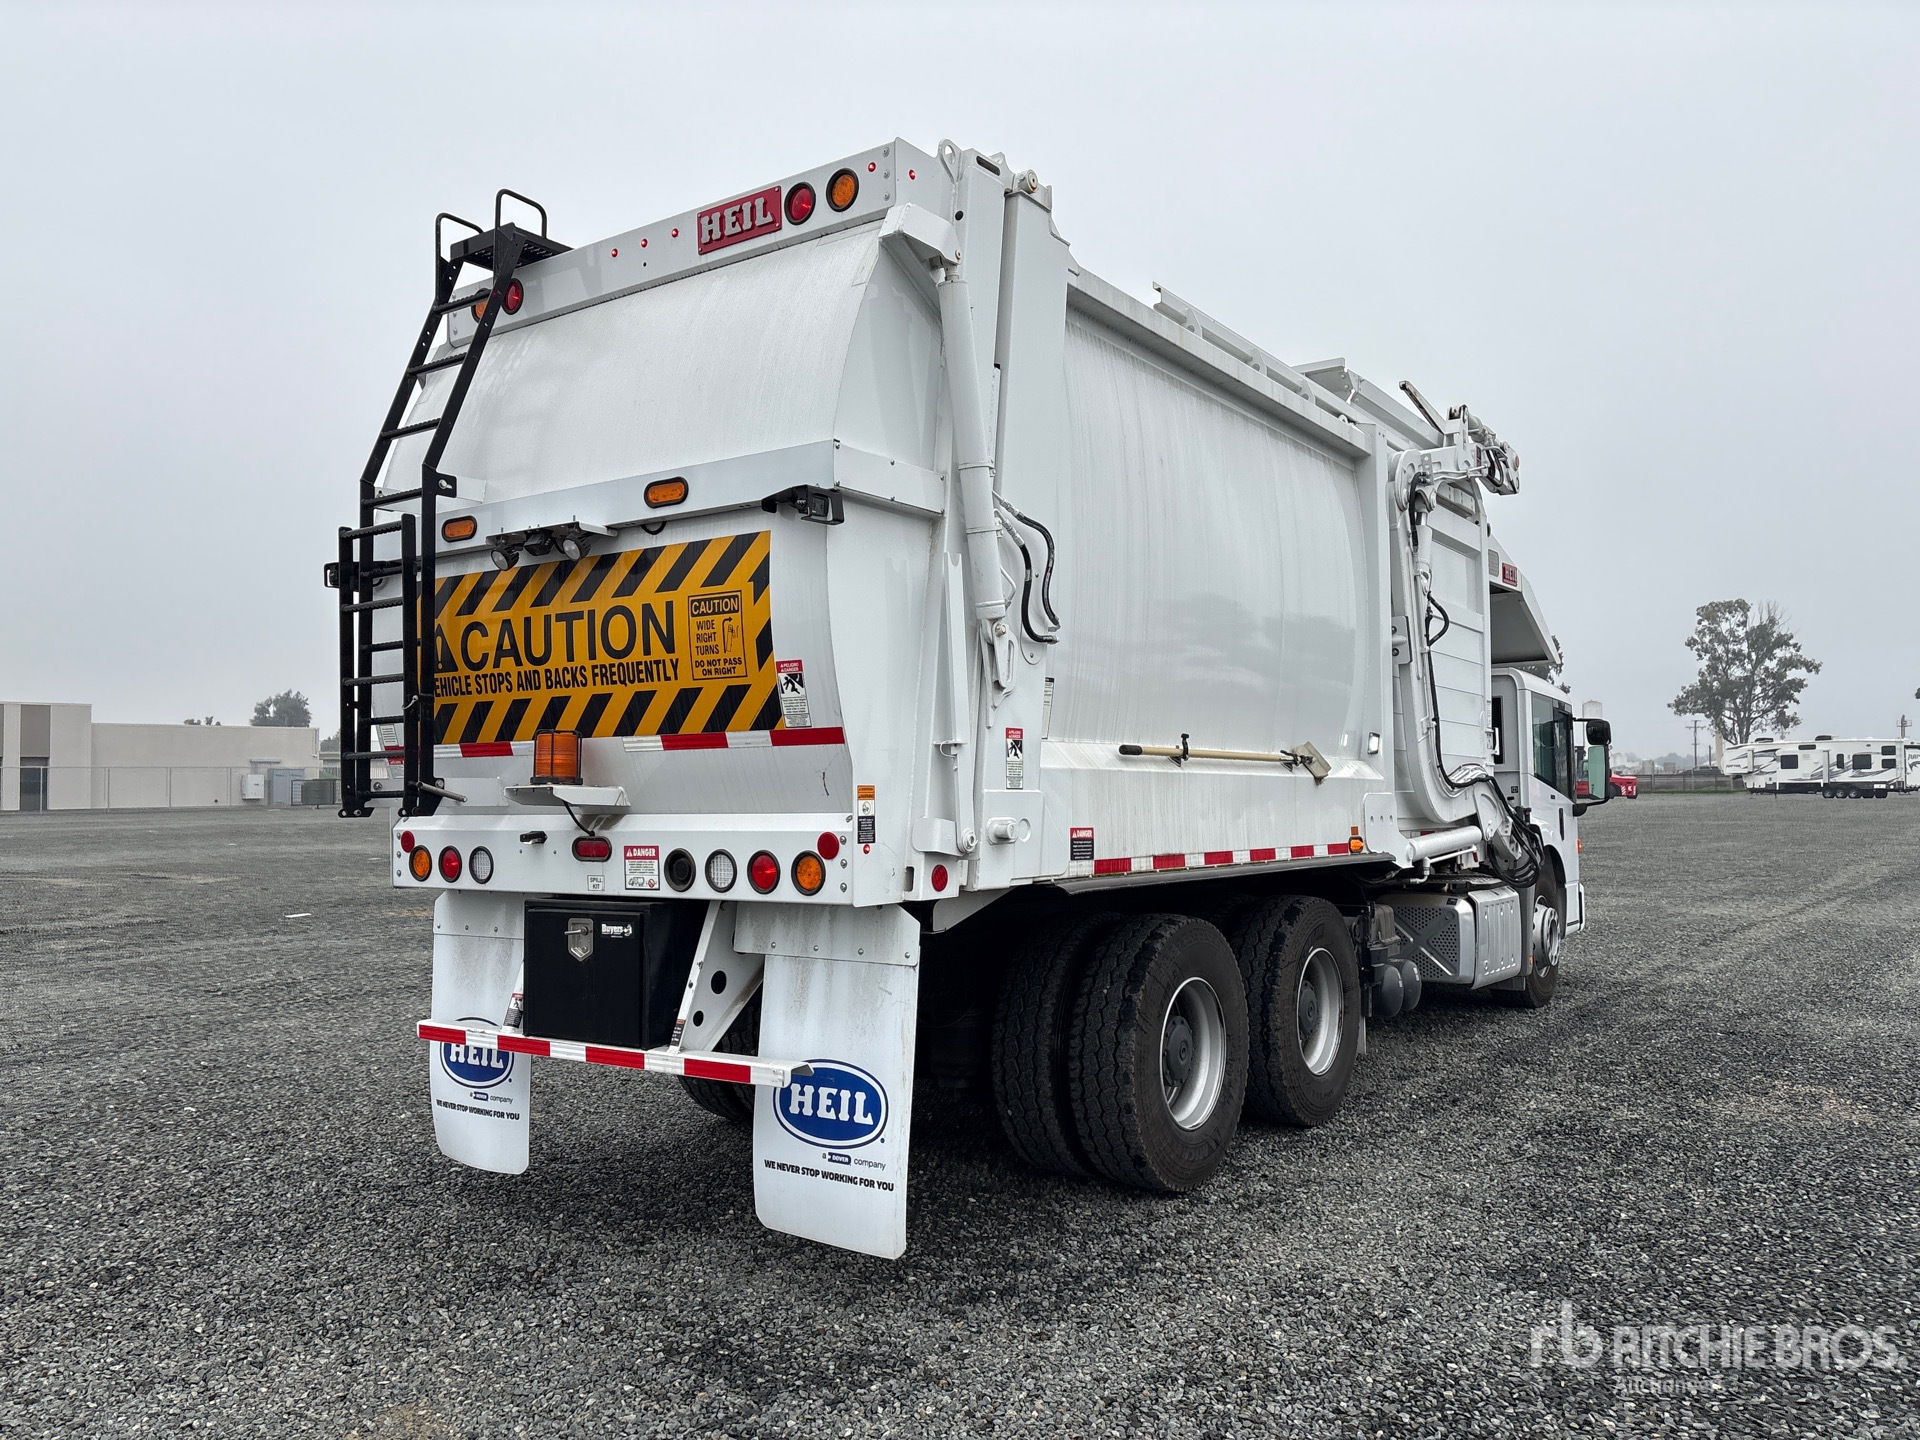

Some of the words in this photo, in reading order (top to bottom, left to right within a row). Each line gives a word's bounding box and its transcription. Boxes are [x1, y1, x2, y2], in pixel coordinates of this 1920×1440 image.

[700, 197, 773, 244] HEIL
[692, 597, 738, 615] CAUTION
[696, 620, 715, 631] WIDE
[461, 600, 675, 671] CAUTION
[696, 632, 717, 643] RIGHT
[695, 644, 719, 656] TURNS
[695, 660, 705, 668] DO
[707, 658, 721, 667] NOT
[724, 657, 742, 666] PASS
[434, 674, 472, 697] EHICLE
[474, 671, 513, 695] STOPS
[517, 669, 541, 692] AND
[544, 665, 588, 690] BACKS
[591, 658, 679, 687] FREQUENTLY
[702, 668, 712, 676] ON
[714, 666, 736, 675] RIGHT
[633, 848, 656, 857] DANGER
[601, 923, 623, 934] Buyers
[490, 1095, 513, 1104] company
[789, 1083, 874, 1125] HEIL
[436, 1099, 442, 1107] WE
[443, 1101, 457, 1110] NEVER
[457, 1104, 468, 1112] STOP
[469, 1107, 492, 1117] WORKING
[493, 1110, 505, 1119] FOR
[505, 1112, 520, 1120] YOU
[832, 1155, 849, 1163] DOVER
[854, 1157, 886, 1170] company
[764, 1159, 775, 1169] WE
[777, 1162, 800, 1174] NEVER
[801, 1166, 820, 1178] STOP
[821, 1170, 858, 1185] WORKING
[859, 1177, 875, 1189] FOR
[876, 1180, 894, 1192] YOU
